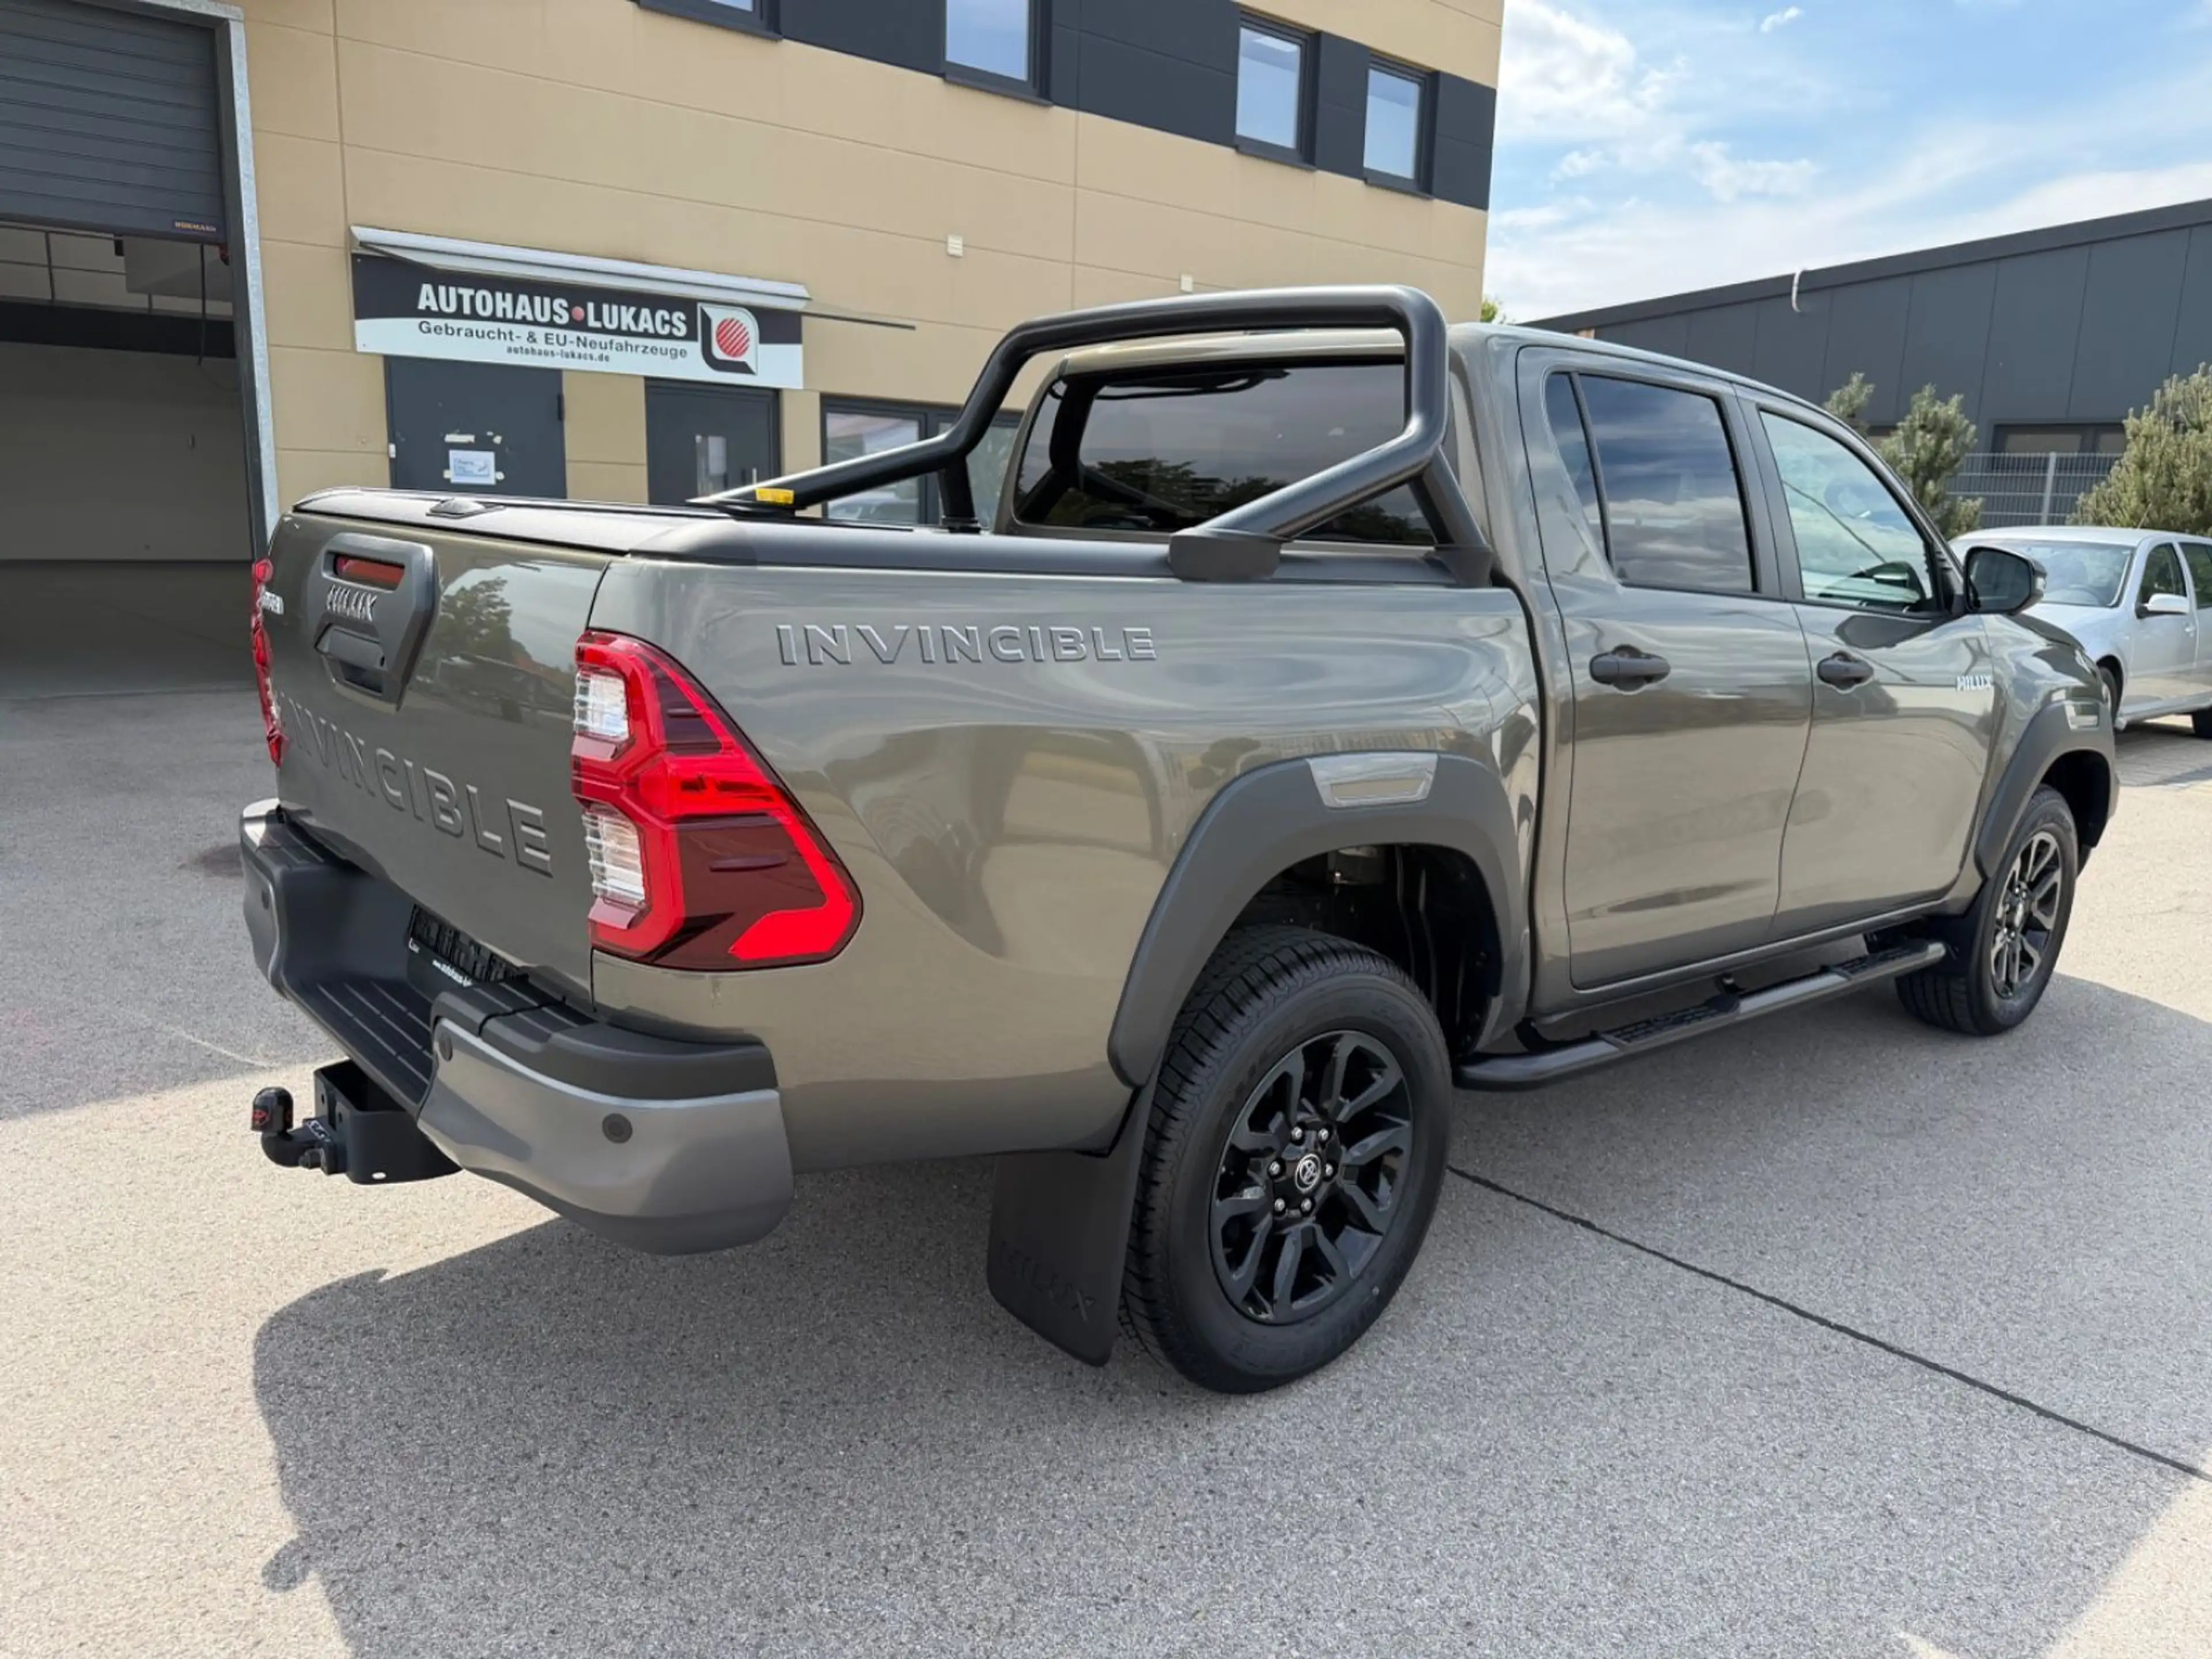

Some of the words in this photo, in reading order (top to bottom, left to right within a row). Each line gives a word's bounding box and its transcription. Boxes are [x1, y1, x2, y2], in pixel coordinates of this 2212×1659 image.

[417, 283, 570, 324] AUTOHAUS
[586, 302, 687, 337] LUKACS
[418, 321, 521, 342] Gebraucht-
[527, 331, 538, 344] &
[544, 333, 688, 359] EU-Neufahrzeuge
[506, 346, 611, 362] autohaus-lukacs.de
[777, 624, 1157, 665] INVINCIBLE
[1956, 675, 1994, 691] HILUX
